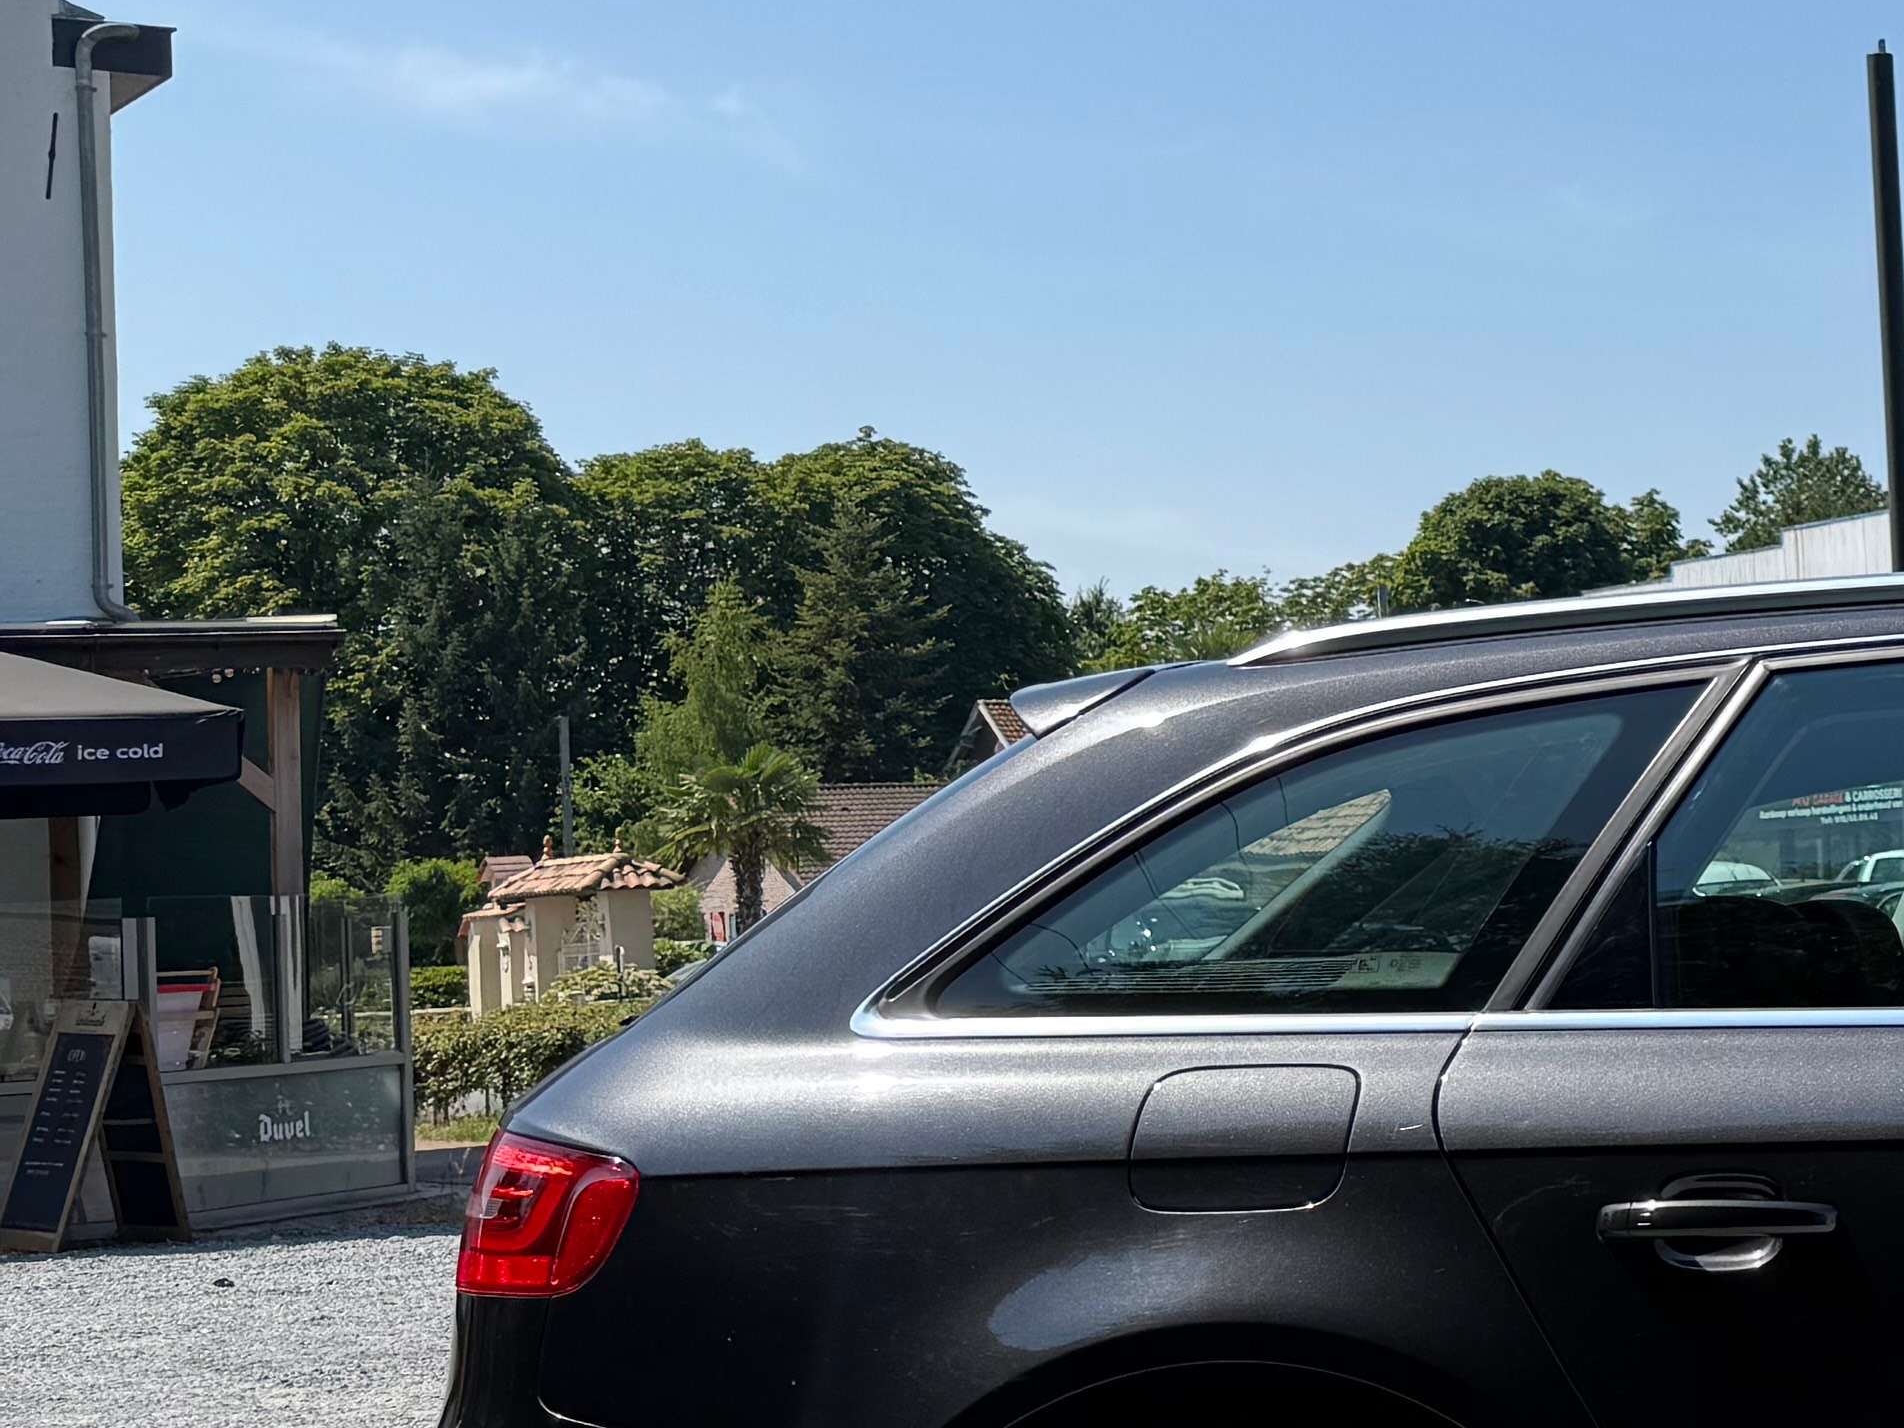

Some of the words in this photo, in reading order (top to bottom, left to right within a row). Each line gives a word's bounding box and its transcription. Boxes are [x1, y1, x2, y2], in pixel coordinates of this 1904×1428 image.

[77, 744, 110, 761] ice
[116, 743, 164, 759] cold
[258, 1110, 311, 1143] Duvel
